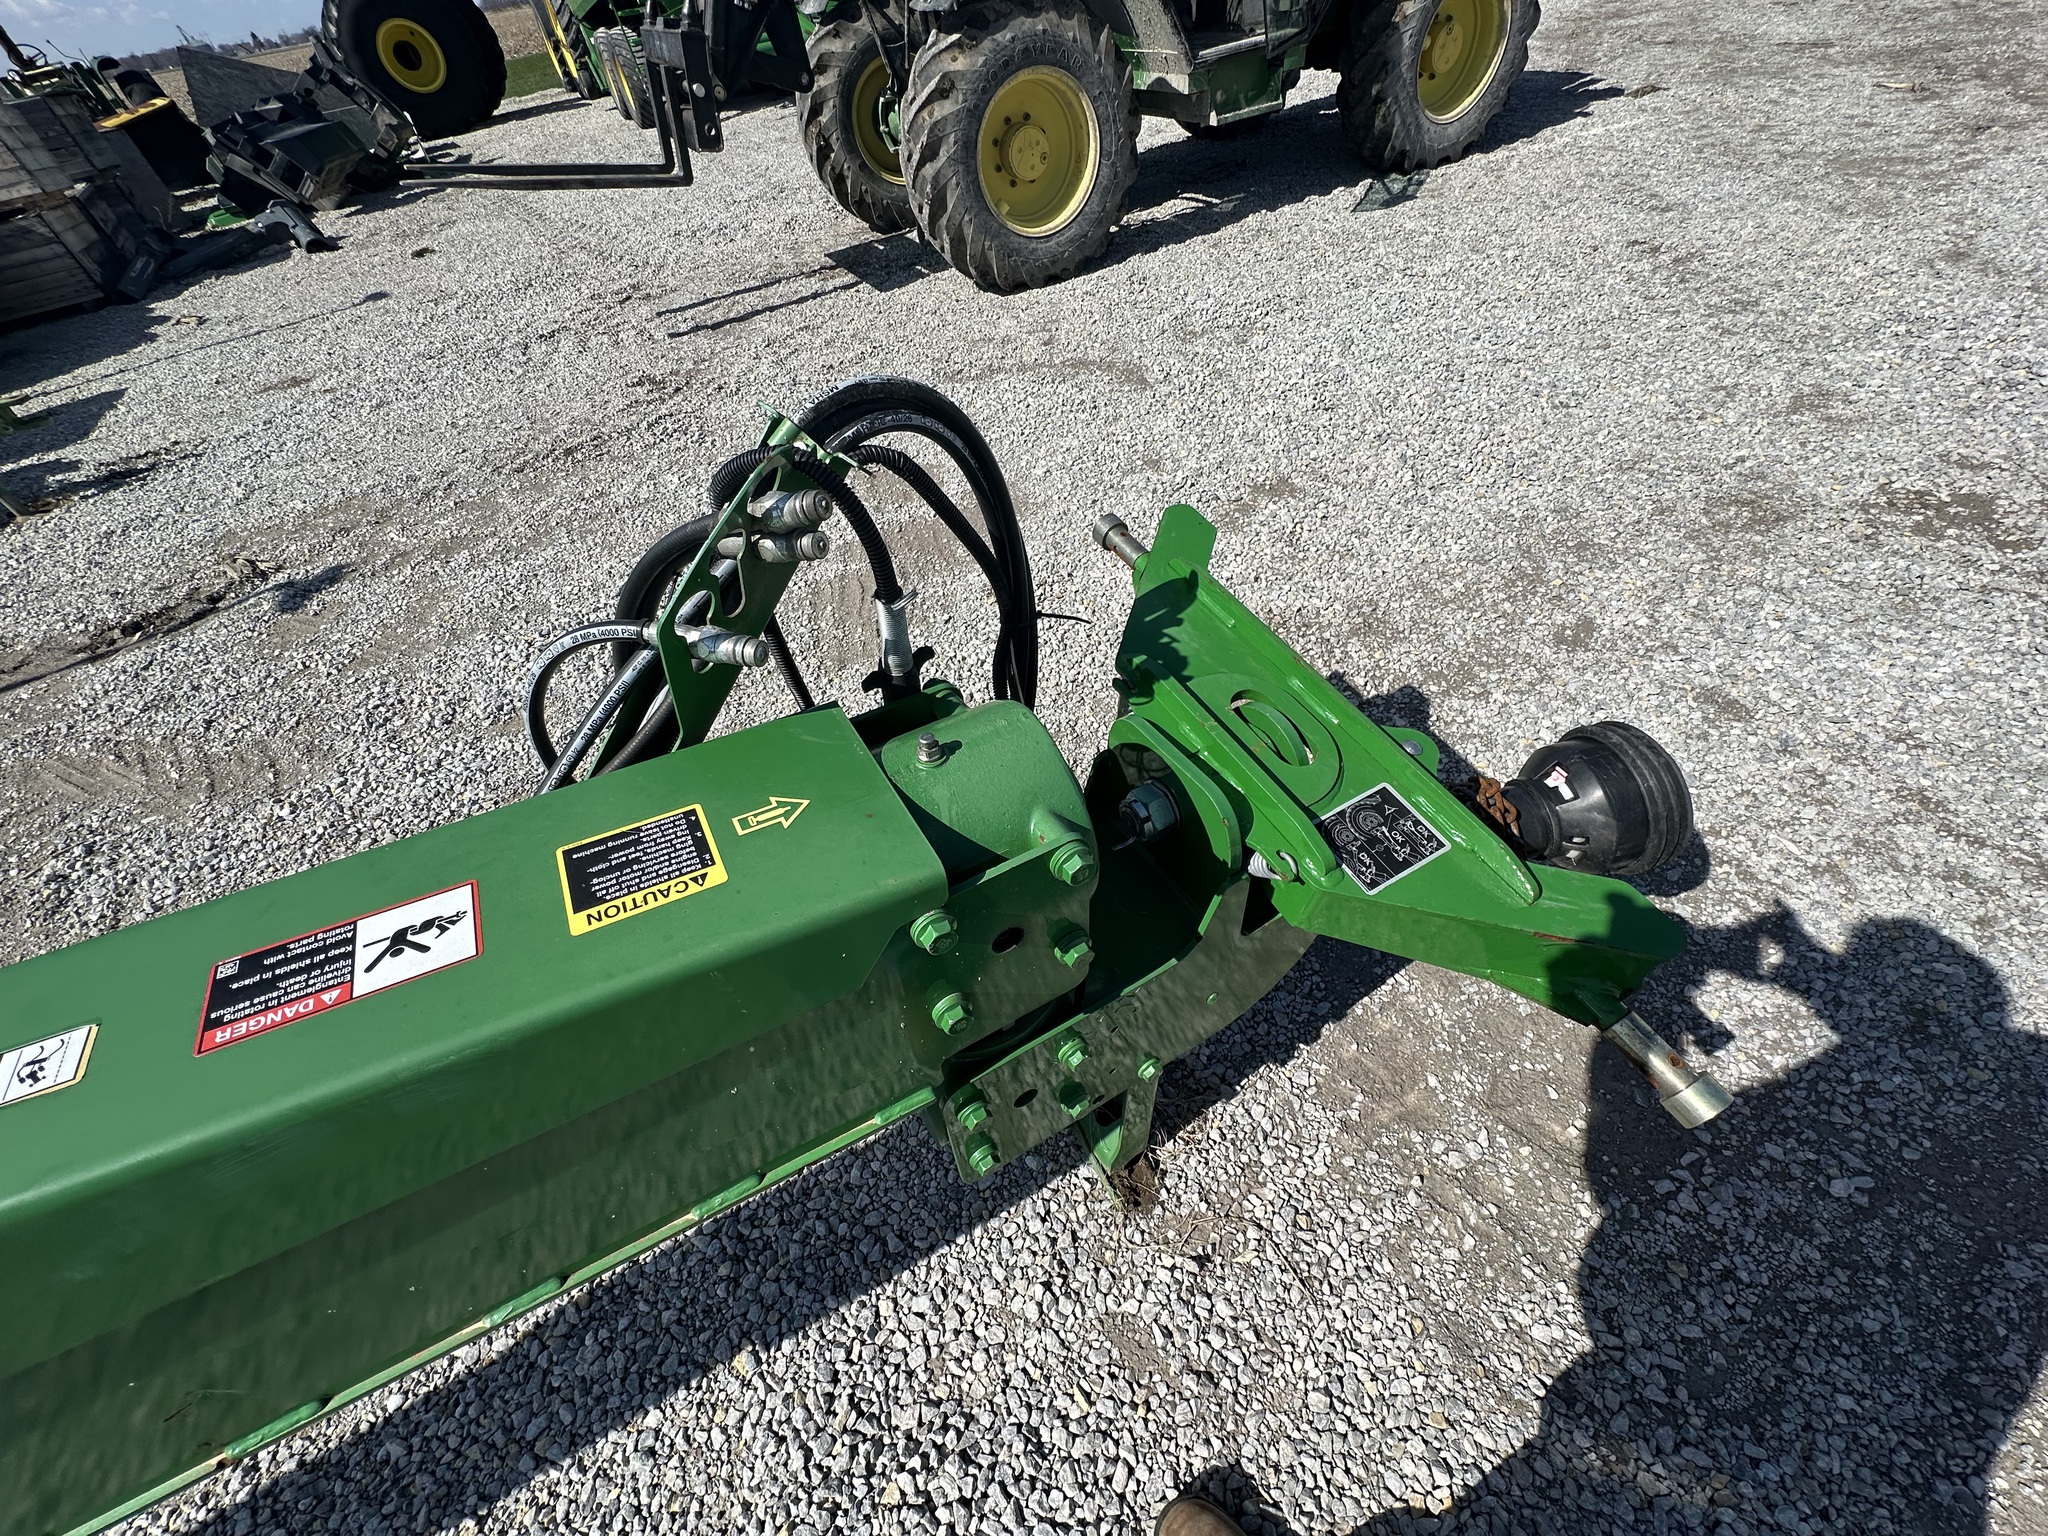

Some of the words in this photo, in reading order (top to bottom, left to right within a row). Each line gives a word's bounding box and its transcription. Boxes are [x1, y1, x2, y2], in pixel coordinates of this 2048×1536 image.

[580, 631, 597, 641] MPa
[597, 628, 619, 638] (4000
[581, 732, 591, 741] 28
[587, 715, 603, 733] MPa
[599, 696, 616, 718] (4000
[615, 681, 631, 698] PSI)
[660, 823, 673, 831] not
[675, 818, 686, 826] Do
[639, 827, 659, 837] leave
[663, 824, 688, 835] driven
[677, 829, 689, 838] ing
[607, 834, 638, 848] running
[656, 833, 676, 844] away
[673, 835, 691, 845] Keep
[635, 840, 655, 850] from
[675, 840, 693, 850] ging
[572, 844, 606, 859] machine
[628, 851, 643, 860] feet
[670, 846, 695, 857] before
[671, 851, 697, 864] engine
[611, 857, 627, 865] and
[633, 853, 669, 870] servicing
[658, 858, 699, 875] Disengage
[681, 863, 702, 874] Keep
[618, 869, 642, 881] motor
[639, 875, 669, 887] shields
[641, 873, 656, 881] and
[591, 878, 616, 891] power
[621, 878, 640, 887] shut
[596, 889, 607, 897] all
[608, 885, 620, 893] off
[586, 881, 689, 926] CAUTION
[317, 925, 354, 940] rotating
[326, 931, 354, 946] Avoid
[286, 935, 315, 948] parts.
[287, 941, 324, 956] contact
[328, 945, 352, 958] Keep
[264, 954, 284, 965] with
[313, 953, 325, 963] all
[274, 958, 311, 974] shields
[323, 959, 352, 972] injury
[263, 971, 272, 979] in
[308, 966, 351, 985] driveline
[310, 969, 321, 977] or
[229, 973, 260, 988] place.
[276, 974, 307, 988] death.
[280, 974, 351, 1003] Entanglement
[288, 982, 305, 992] can
[253, 989, 284, 1003] cause
[210, 1001, 250, 1019] serious
[223, 1005, 265, 1022] rotating
[215, 998, 314, 1043] DANGER
